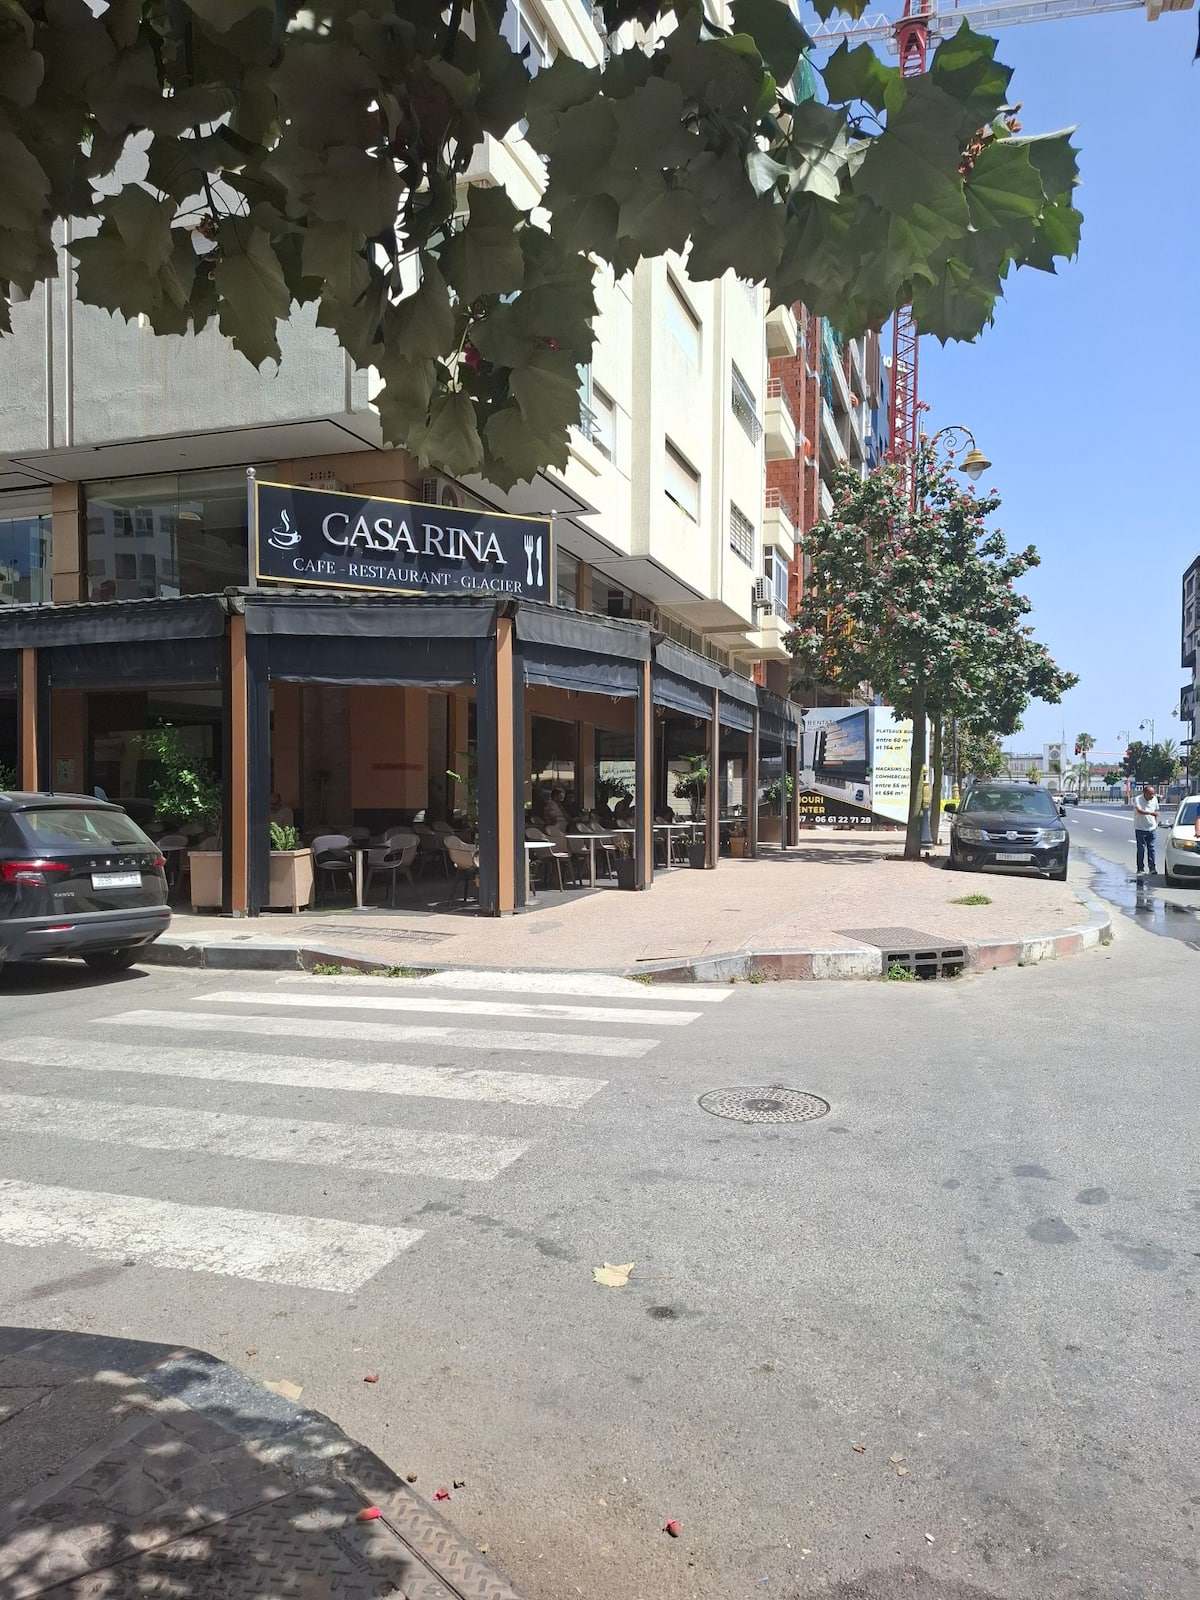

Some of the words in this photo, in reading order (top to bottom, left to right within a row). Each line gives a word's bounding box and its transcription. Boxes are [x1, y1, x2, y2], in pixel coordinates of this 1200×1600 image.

[292, 557, 336, 575] CAFE
[349, 563, 451, 586] RESTAURANT
[460, 575, 522, 593] GLACIER
[838, 816, 849, 824] 22
[849, 816, 859, 824] 71
